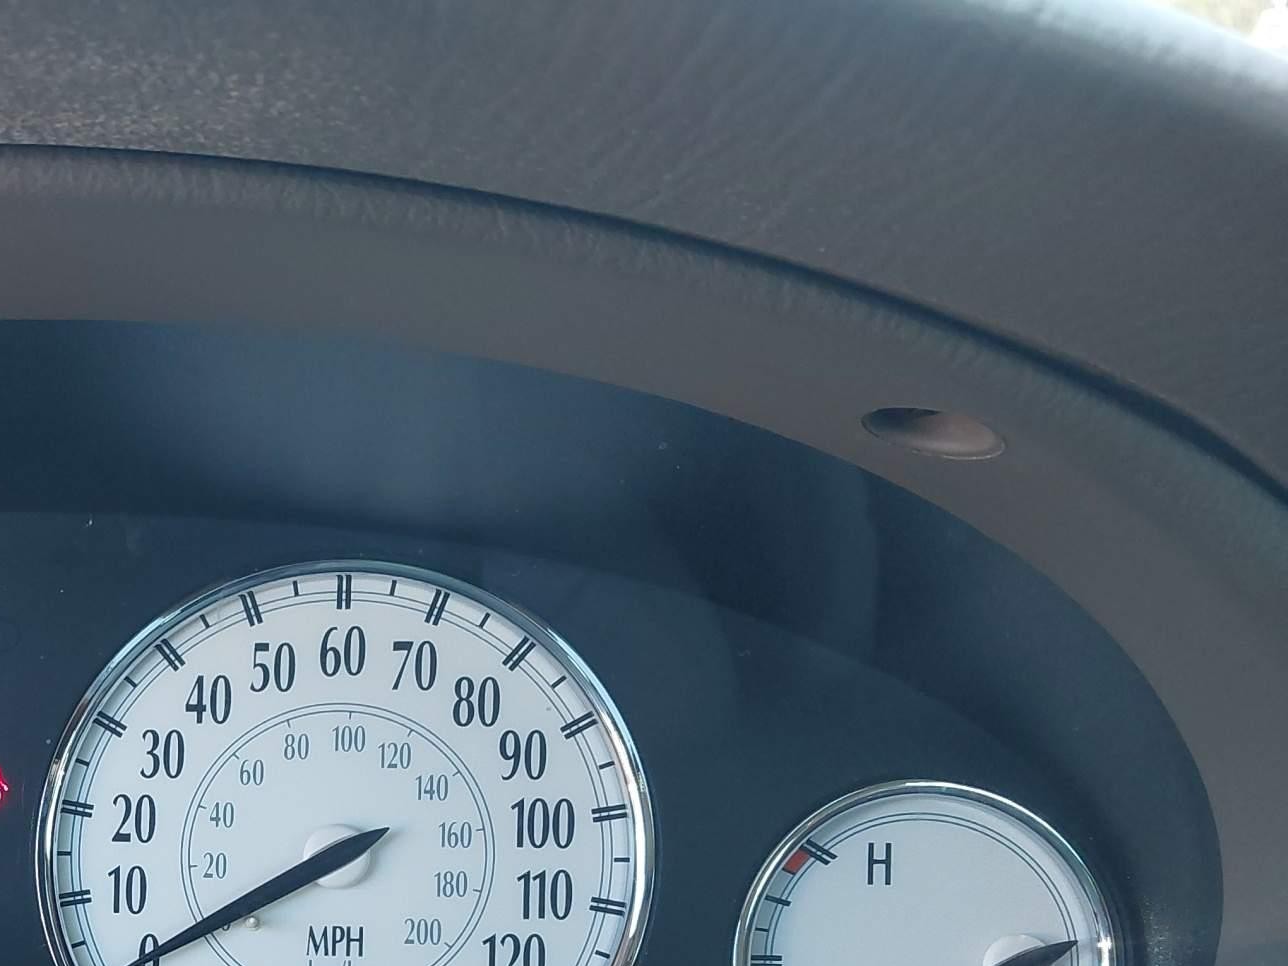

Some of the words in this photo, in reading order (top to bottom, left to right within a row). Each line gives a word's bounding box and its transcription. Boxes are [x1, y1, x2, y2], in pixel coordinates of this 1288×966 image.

[250, 643, 296, 692] 50
[319, 626, 366, 676] 60
[391, 641, 437, 691] 70
[186, 675, 231, 724] 40
[453, 677, 500, 727] 80
[140, 730, 185, 778] 30
[284, 733, 309, 760] 80
[332, 725, 366, 753] 100
[378, 743, 411, 770] 120
[499, 730, 547, 780] 90
[239, 759, 264, 786] 60
[416, 774, 449, 802] 140
[112, 794, 156, 843] 20
[209, 803, 234, 828] 40
[439, 822, 472, 849] 160
[511, 798, 575, 848] 100
[203, 853, 227, 879] 20
[434, 871, 468, 898] 180
[867, 842, 892, 885] H
[108, 866, 146, 914] 10
[517, 870, 573, 920] 110
[306, 926, 364, 958] MPH
[404, 919, 442, 946] 200
